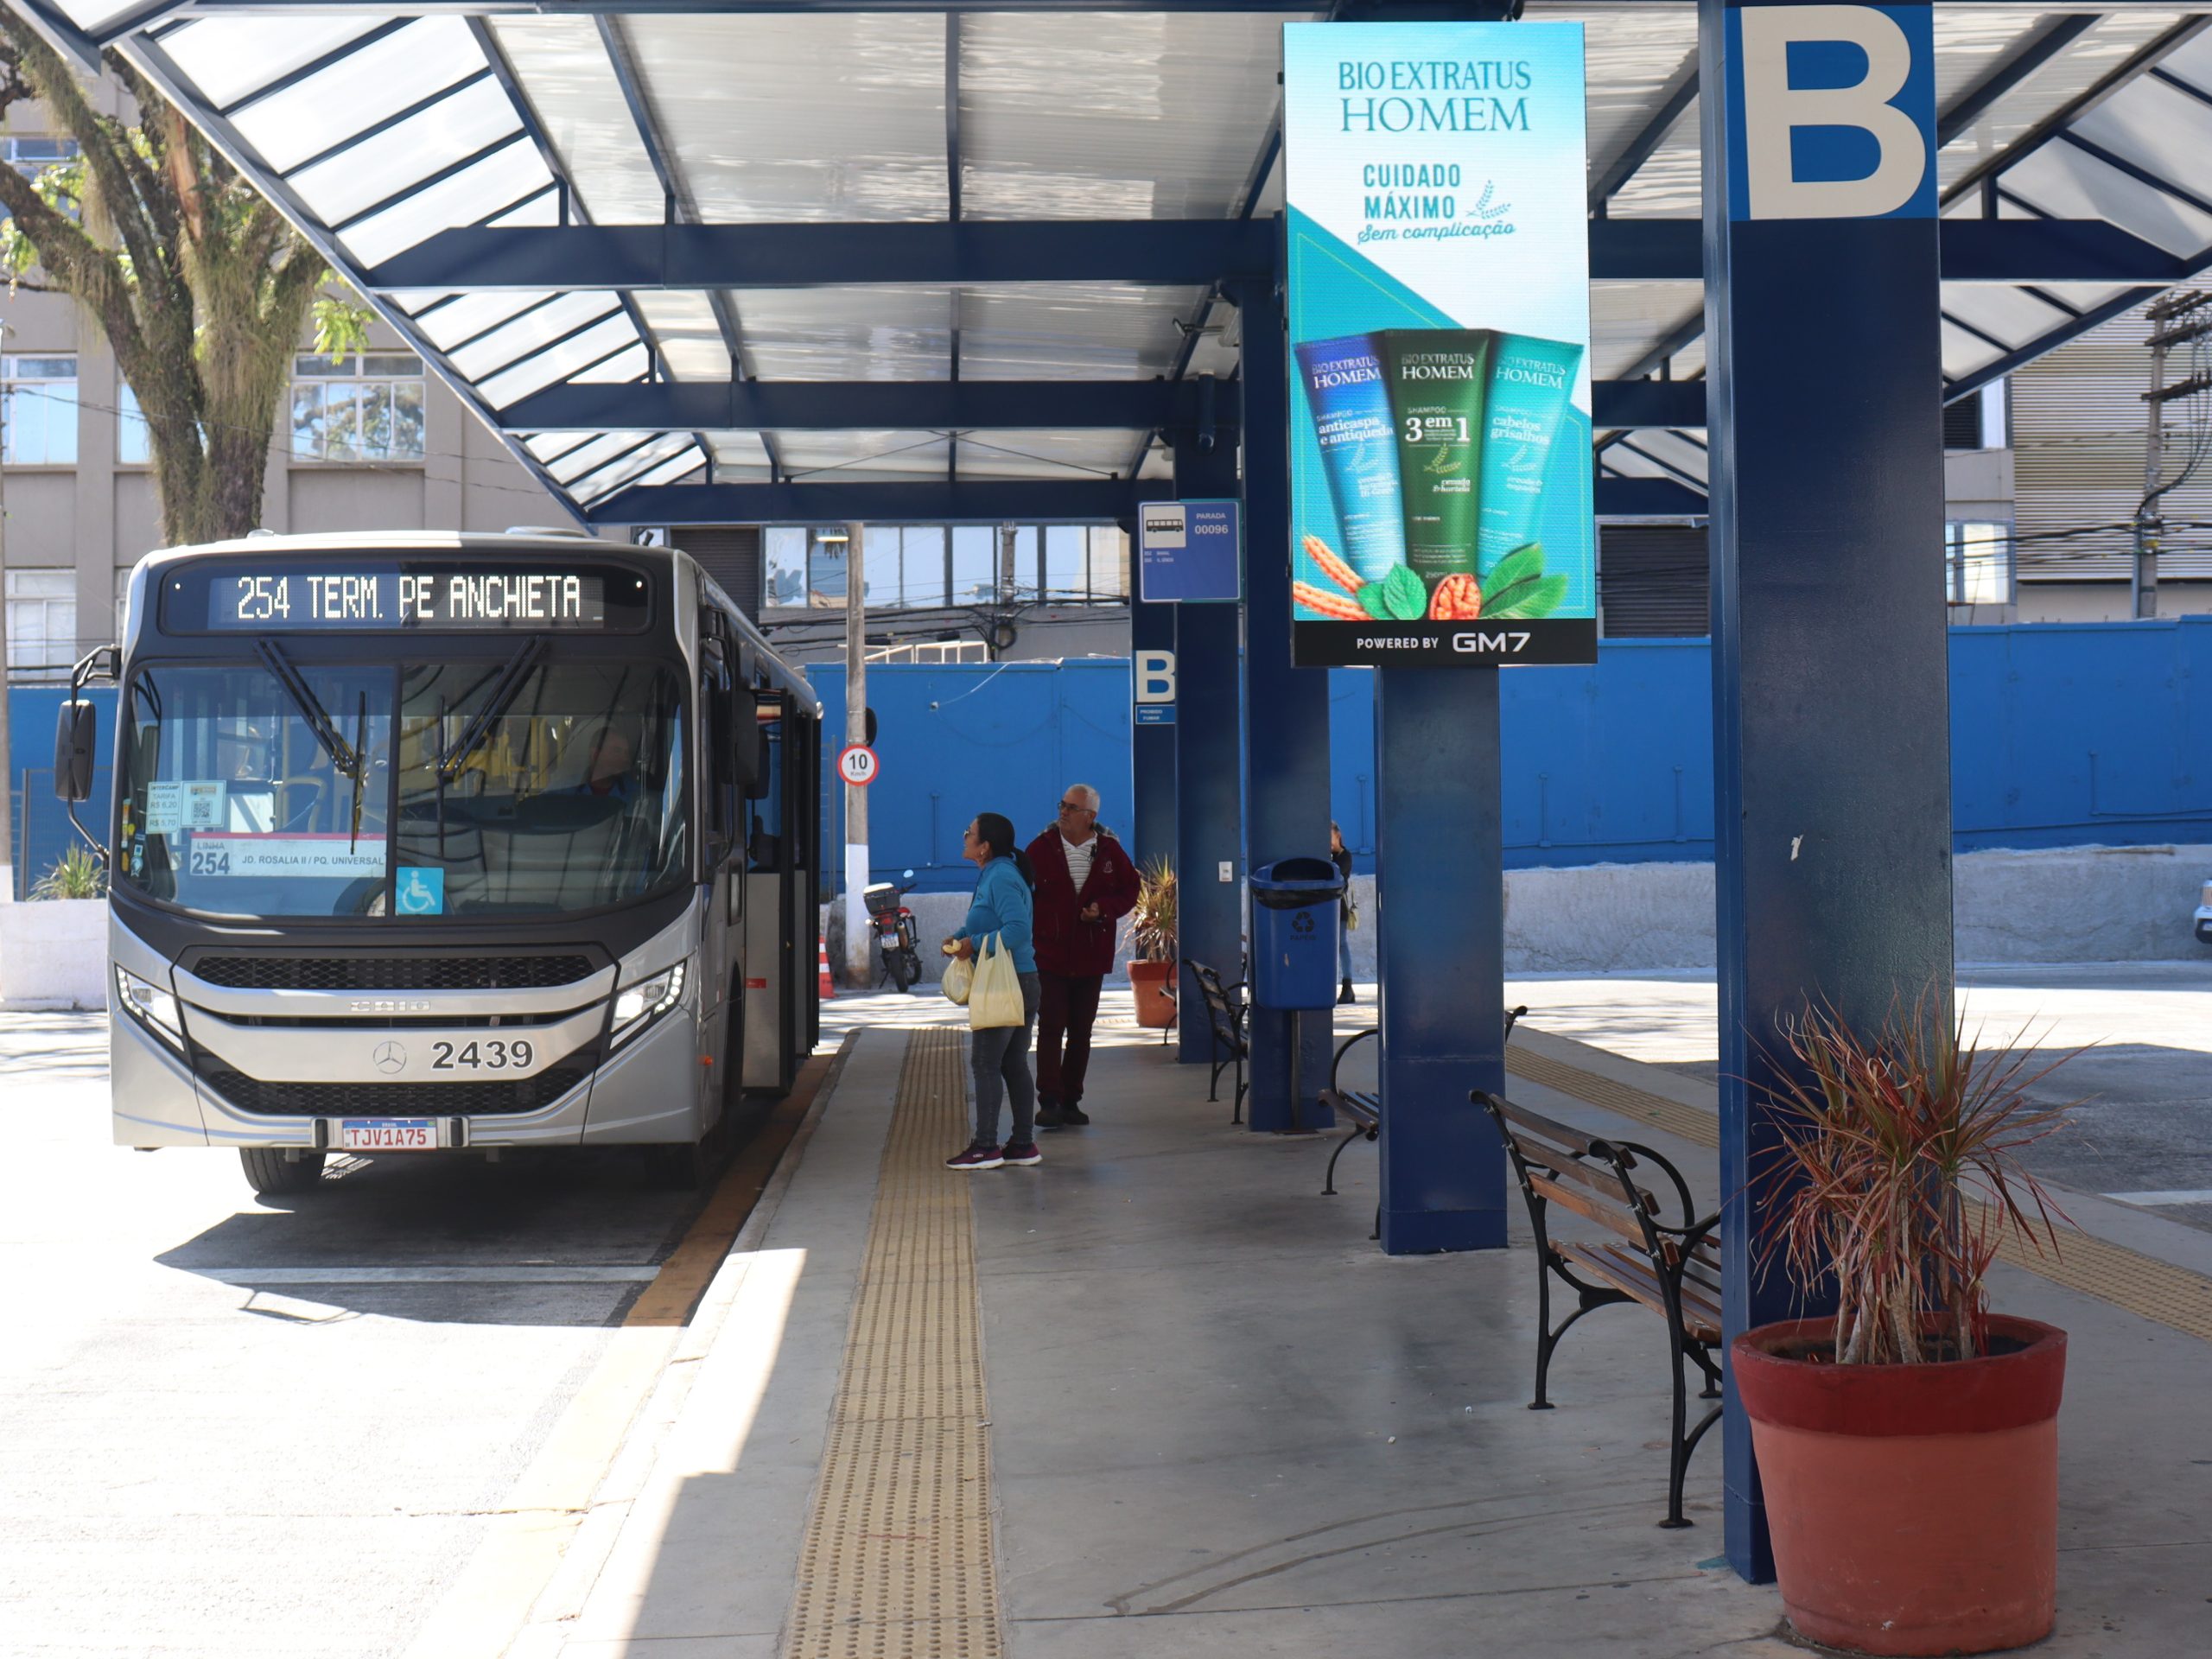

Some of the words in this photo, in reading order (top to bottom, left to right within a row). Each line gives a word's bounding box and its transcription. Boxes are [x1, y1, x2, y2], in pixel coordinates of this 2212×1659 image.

[1338, 61, 1385, 90] BIO
[1391, 61, 1532, 90] EXTRATUS
[1341, 98, 1531, 131] HOMEM
[1741, 4, 1926, 220] B
[1363, 163, 1461, 188] CUIDADO
[1364, 191, 1455, 219] MÁXIMO
[1357, 224, 1398, 245] Sem
[1402, 219, 1516, 241] complicação
[1421, 353, 1475, 365] EXTRATUS
[1314, 367, 1382, 389] HOMEM
[1402, 365, 1473, 379] HOMEM
[1496, 366, 1563, 390] HOMEM
[1319, 416, 1380, 435] anticaspa
[1329, 423, 1395, 444] antiqueda
[1405, 416, 1423, 442] 3
[1425, 416, 1452, 428] em
[1456, 416, 1471, 442] 1
[1492, 416, 1541, 431] cabelos
[1195, 524, 1229, 534] 00096
[238, 576, 290, 619] 254
[307, 576, 384, 619] TERM.
[399, 576, 434, 618] PE
[450, 576, 580, 618] ANCHIETA
[1357, 638, 1419, 649] POWERED
[1422, 638, 1439, 648] BY
[1452, 632, 1530, 652] GM7
[1135, 650, 1176, 702] B
[849, 753, 868, 770] 10
[192, 852, 230, 874] 254
[259, 855, 298, 864] ROSALIA
[332, 855, 384, 865] UNIVERSAL
[351, 1001, 429, 1012] CAIO
[431, 1040, 533, 1070] 2439
[351, 1128, 427, 1146] TJV1A75
